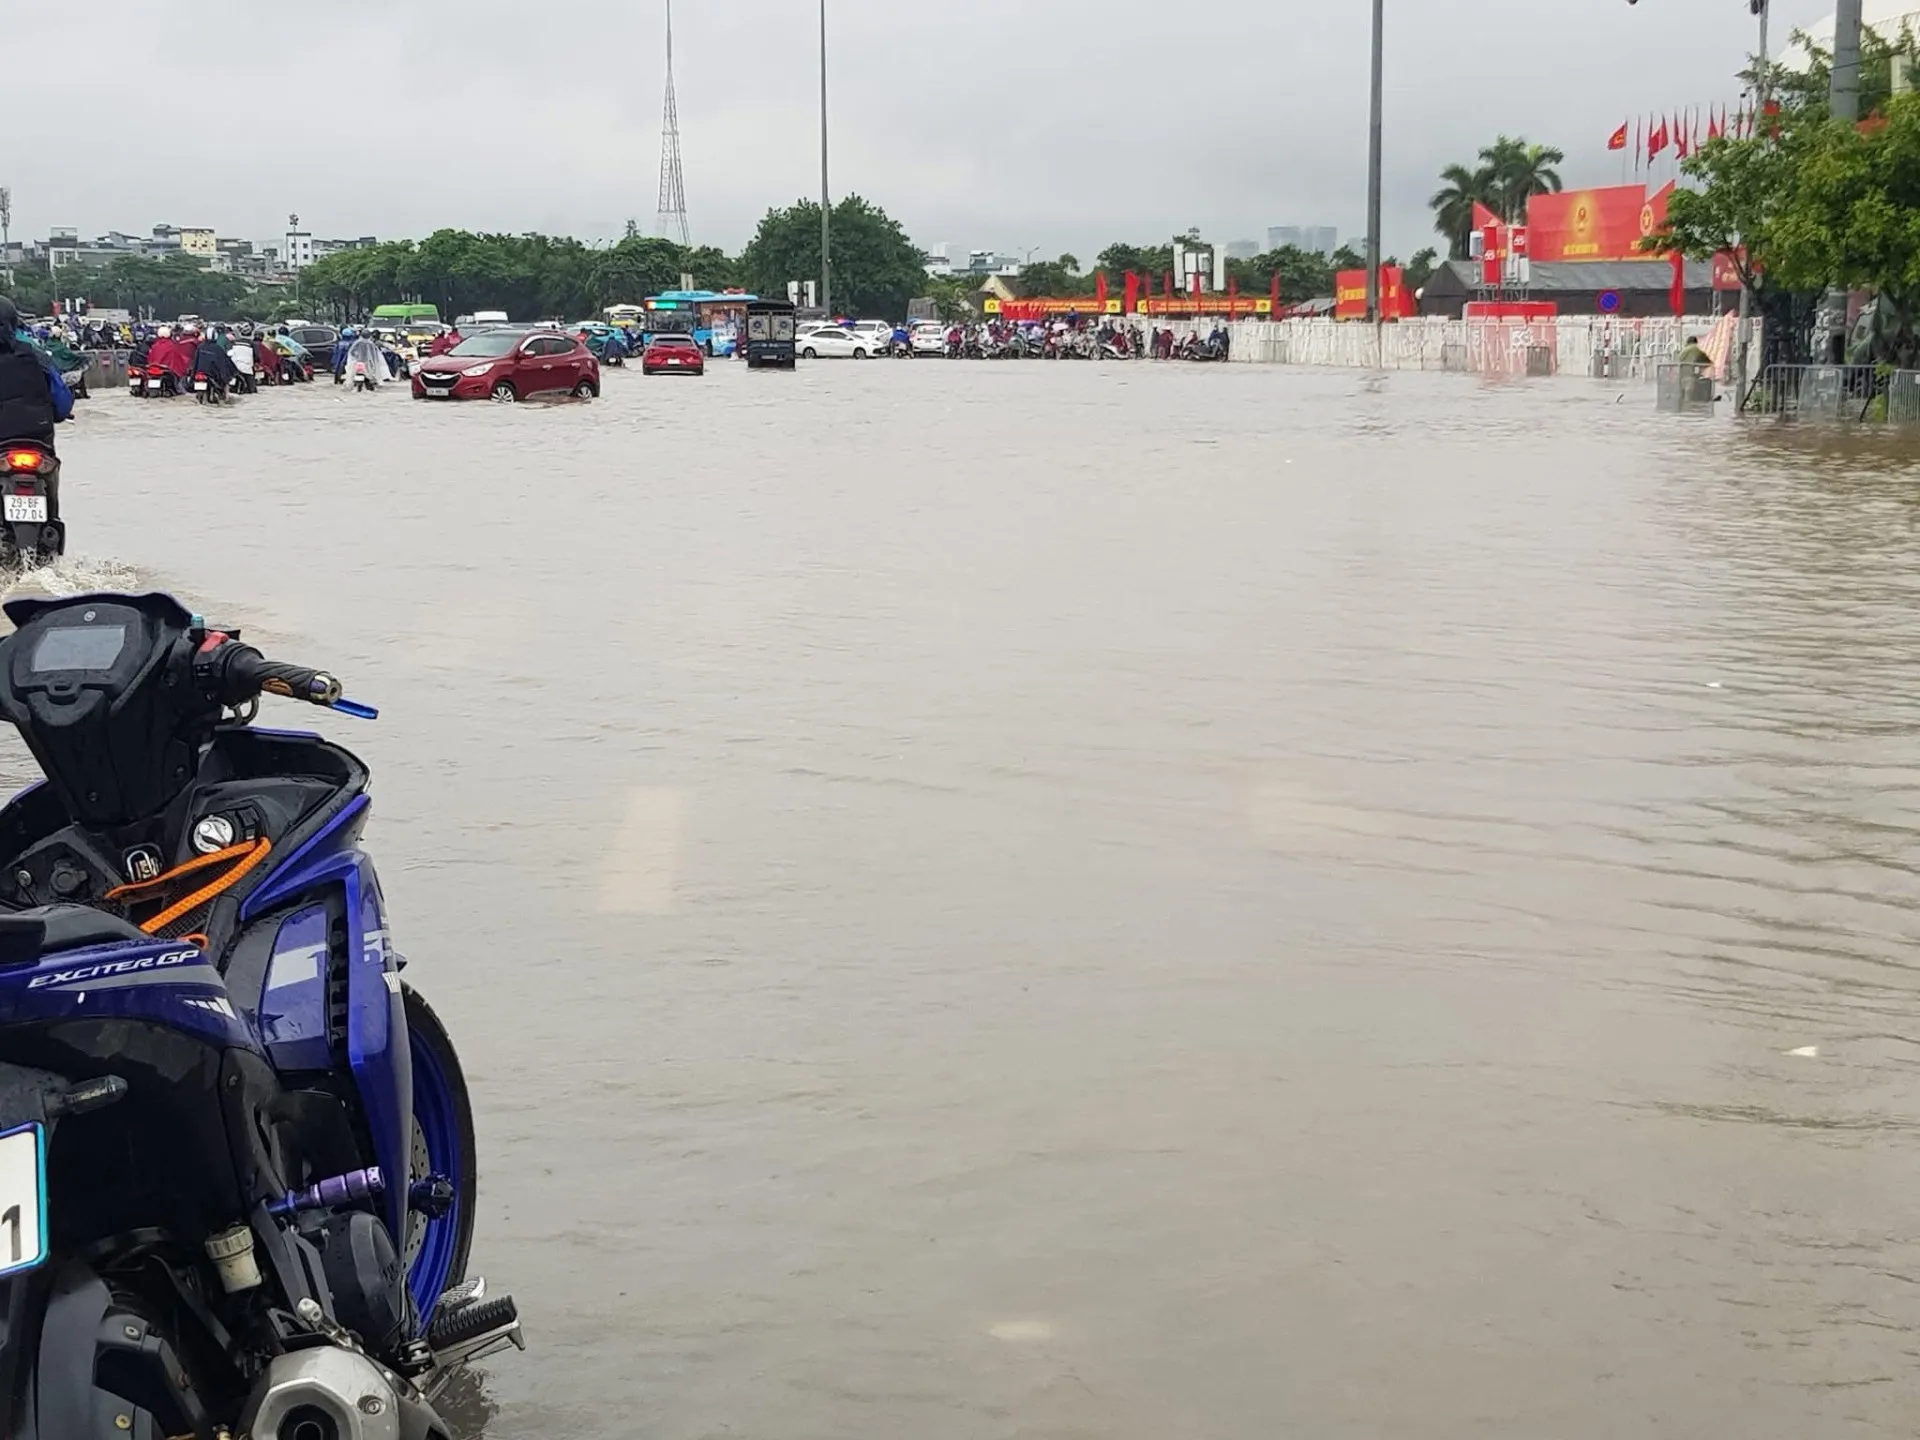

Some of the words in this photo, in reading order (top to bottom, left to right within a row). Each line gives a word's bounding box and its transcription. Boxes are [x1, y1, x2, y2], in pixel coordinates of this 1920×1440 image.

[28, 957, 153, 988] EXCITER
[156, 950, 200, 965] GP
[1, 1204, 21, 1262] 1
